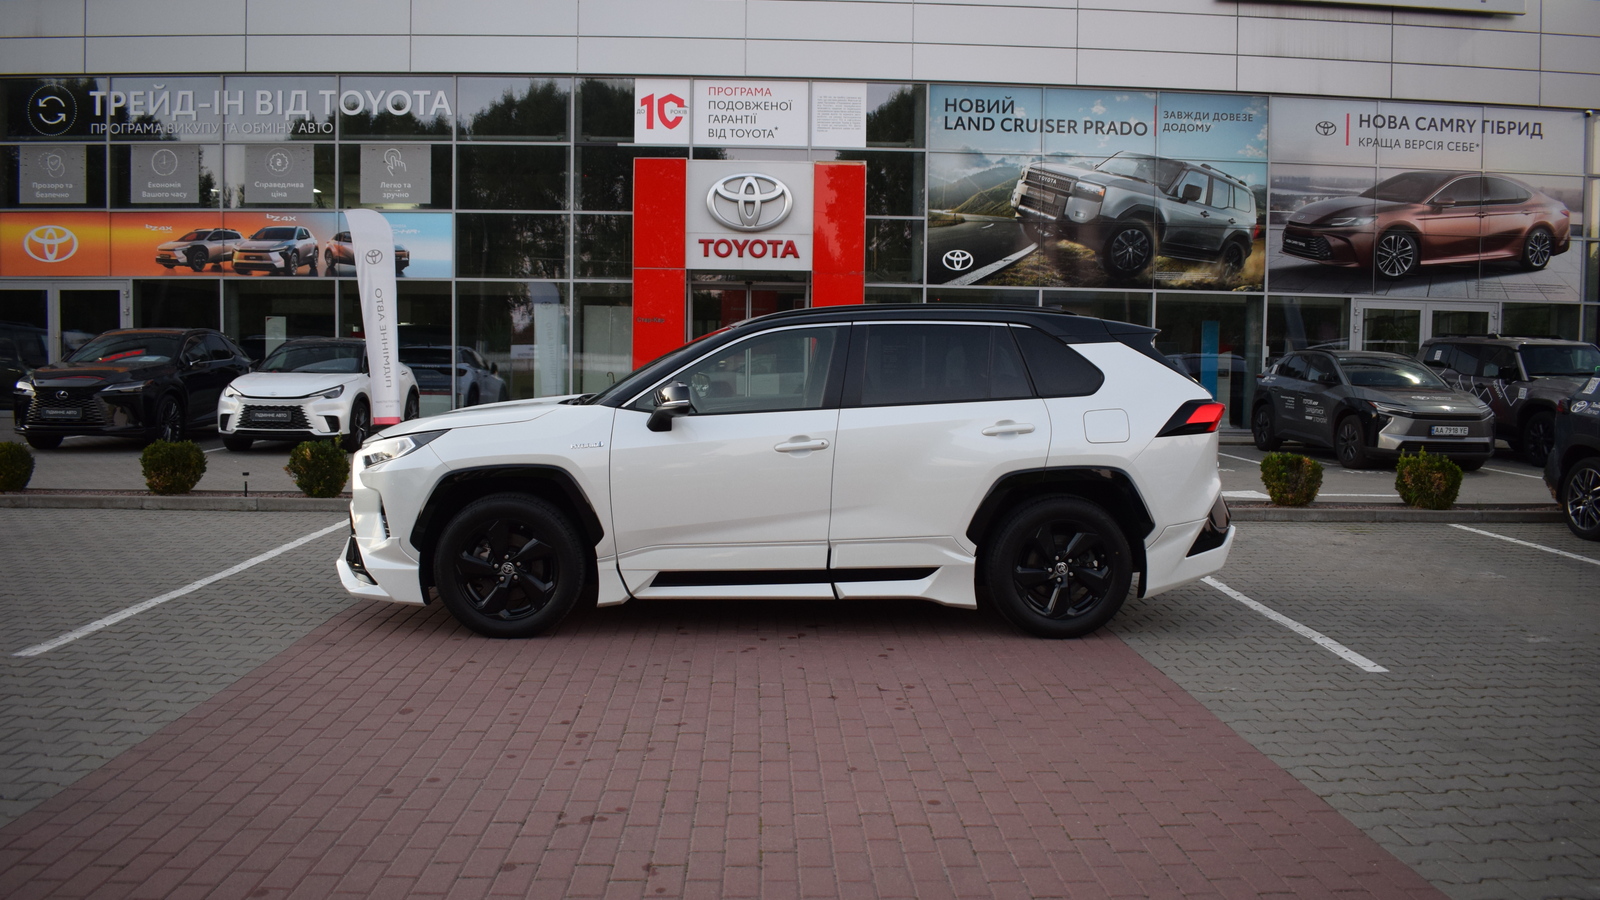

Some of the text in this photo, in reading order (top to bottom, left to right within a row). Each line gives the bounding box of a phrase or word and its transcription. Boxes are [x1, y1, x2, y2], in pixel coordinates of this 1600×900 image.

[708, 86, 773, 97] ПРОГРАМА
[89, 84, 453, 121] ТРЕЙД-ІН ВІД TOYOTA
[708, 99, 794, 112] ПОДОВЖЕНОЇ
[944, 96, 1015, 115] НОВИЙ
[640, 93, 685, 130] 10
[1163, 110, 1254, 122] ЗАВЖДИ ДОВЕЗЕ
[708, 112, 758, 125] ГАРАНТІЇ
[90, 122, 334, 135] ПРОГРАМА ВИКУПУ ТА ОБМІНУ АВТО
[944, 115, 1149, 137] LAND CRUISER PRADO
[1162, 122, 1212, 133] ДОДОМУ
[1359, 114, 1544, 140] НОВА CAMRY ГІБРИД
[708, 128, 727, 140] ВІД
[1358, 137, 1402, 150] КРАЩА
[1404, 139, 1444, 151] ВЕРСІЯ
[32, 182, 64, 190] Прозоро
[147, 181, 182, 189] Економія
[254, 180, 305, 190] Справедлива
[379, 181, 402, 190] Легко
[35, 191, 70, 199] безпечно
[141, 191, 170, 199] Вашого
[271, 191, 288, 199] ціна
[382, 192, 410, 200] зручно
[698, 238, 800, 259] TOYOTA
